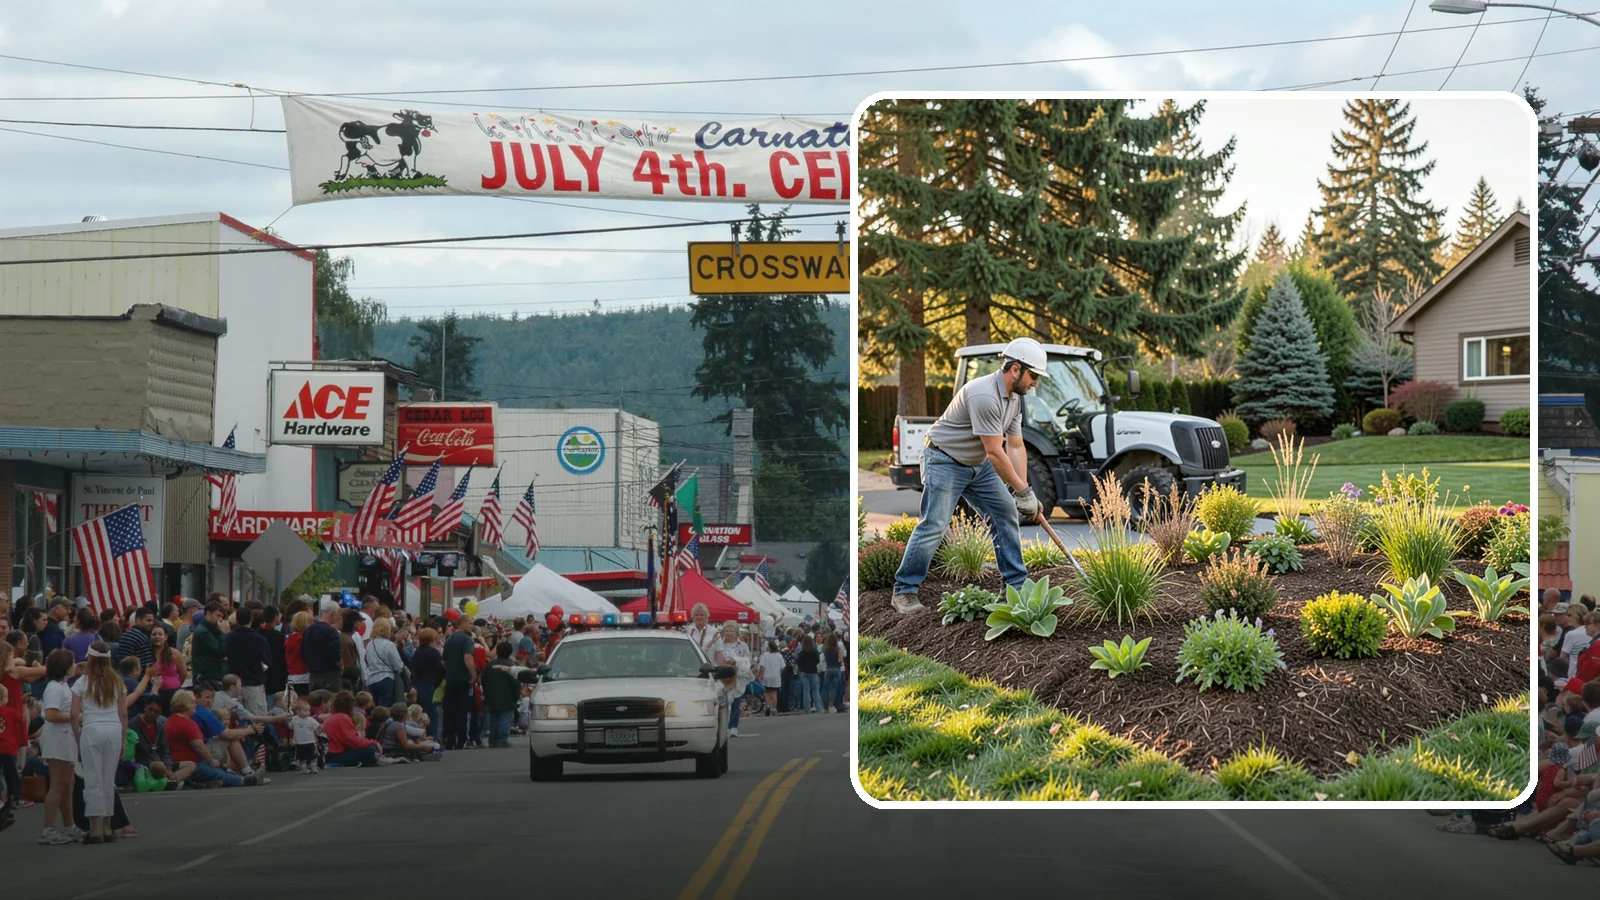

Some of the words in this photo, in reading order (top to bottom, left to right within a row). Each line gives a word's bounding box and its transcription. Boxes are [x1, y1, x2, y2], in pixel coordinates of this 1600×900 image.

[481, 141, 604, 192] JULY
[633, 150, 746, 198] 4th.
[697, 254, 850, 280] CROSSWA
[283, 380, 373, 419] ACE
[405, 409, 452, 422] CEDAR
[283, 421, 371, 436] Hardware
[416, 428, 476, 446] Coca-Cola
[96, 485, 124, 494] Vincent
[126, 486, 135, 494] de
[137, 486, 155, 495] Paul
[213, 516, 331, 535] HARDARE
[688, 526, 741, 535] CRNATION
[699, 535, 730, 543] GLASS
